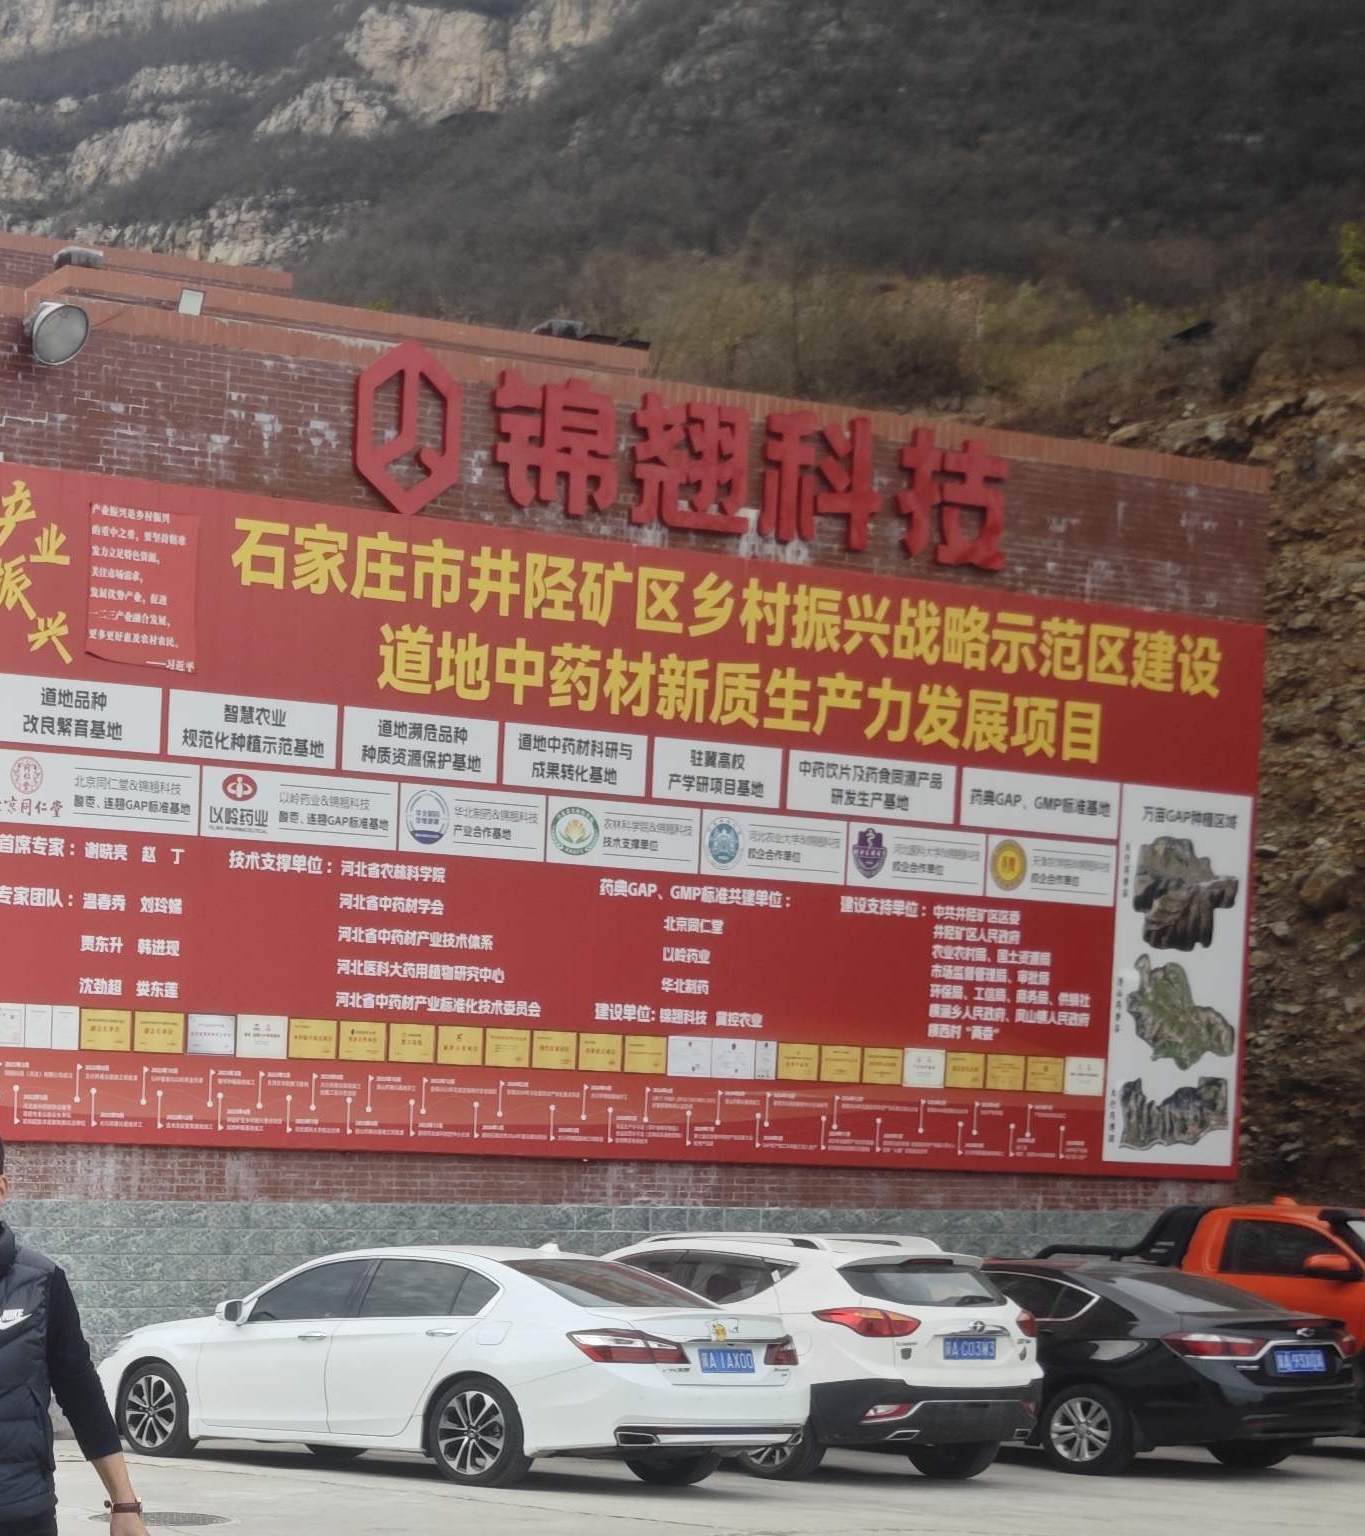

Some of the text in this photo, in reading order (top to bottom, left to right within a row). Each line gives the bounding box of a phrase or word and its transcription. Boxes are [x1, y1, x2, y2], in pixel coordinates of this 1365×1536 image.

[493, 369, 1008, 571] 锦翘科技
[231, 517, 1223, 699] 石家庄市井陉矿区乡村振兴战略示范区建设
[40, 686, 107, 711] 道地品种
[377, 623, 1102, 763] 道地中药材新质生产力发展项目
[22, 714, 123, 741] 改良繁育基地
[223, 704, 287, 728] 智慧农业
[181, 728, 325, 759] 规范化种植示范基地
[377, 719, 468, 745] 道地濒危品种
[361, 744, 482, 773] 种质资源保护基地
[517, 732, 633, 761] 道地中药材科研与
[531, 760, 618, 785] 成果转化基地
[689, 749, 746, 771] 驻冀高校
[668, 772, 765, 799] 产学研项目基地
[798, 760, 943, 789] 中药饮片及药食同源产品
[830, 788, 910, 812] 研发生产基地
[969, 788, 1111, 818] 药典GAP、GMP标准基地
[208, 805, 269, 828] 以岭药业
[338, 893, 444, 915] 河北省中药材学会
[337, 926, 494, 950] 河北省中药材产业技术体系
[663, 916, 724, 935] 北京同仁堂
[80, 934, 124, 954] 贾东升
[662, 946, 711, 964] 以岭药业
[336, 959, 505, 984] 河北医科大药用植物研究中心
[660, 977, 709, 995] 华北制药
[335, 991, 542, 1017] 河北省中药材产业标准化技术委员会
[1, 1309, 24, 1321] NIKE
